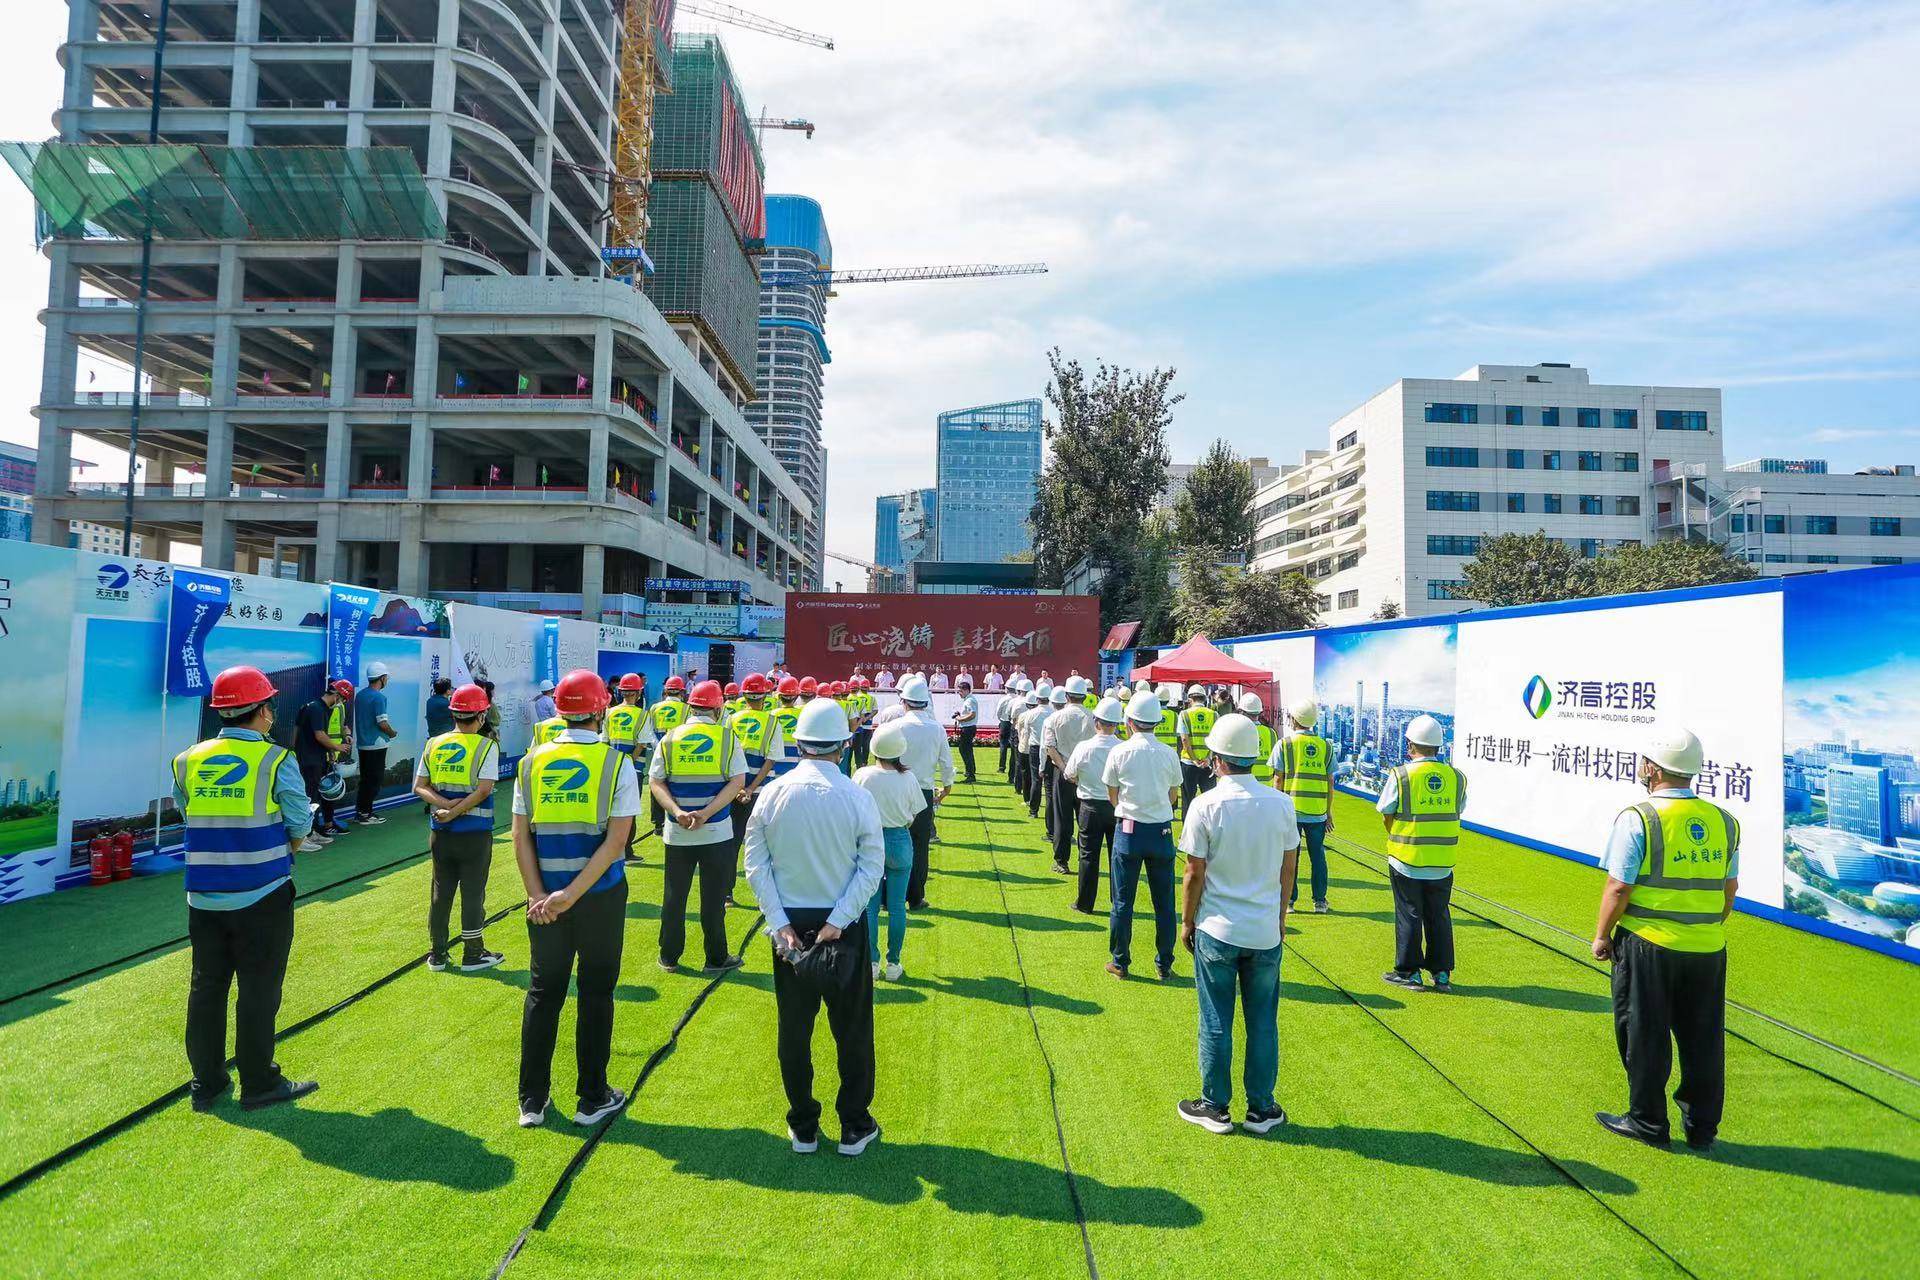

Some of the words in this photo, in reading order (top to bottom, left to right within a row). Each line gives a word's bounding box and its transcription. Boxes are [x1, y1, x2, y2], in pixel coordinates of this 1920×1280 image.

[96, 588, 129, 598] 天元集团
[223, 602, 283, 621] 美好家园
[827, 622, 935, 658] 匠心浇铸
[942, 624, 1055, 658] 喜封金顶
[1557, 681, 1656, 710] 济高控股
[1557, 711, 1575, 719] JINAN
[1576, 713, 1599, 721] HI-TECH
[1601, 714, 1629, 723] HOLDING
[1631, 716, 1656, 725] GROUP
[679, 755, 714, 763] 天元集团
[1466, 732, 1753, 803] 打造世界一流科技园营商
[194, 786, 246, 799] 天元集团
[540, 792, 589, 804] 天元集团
